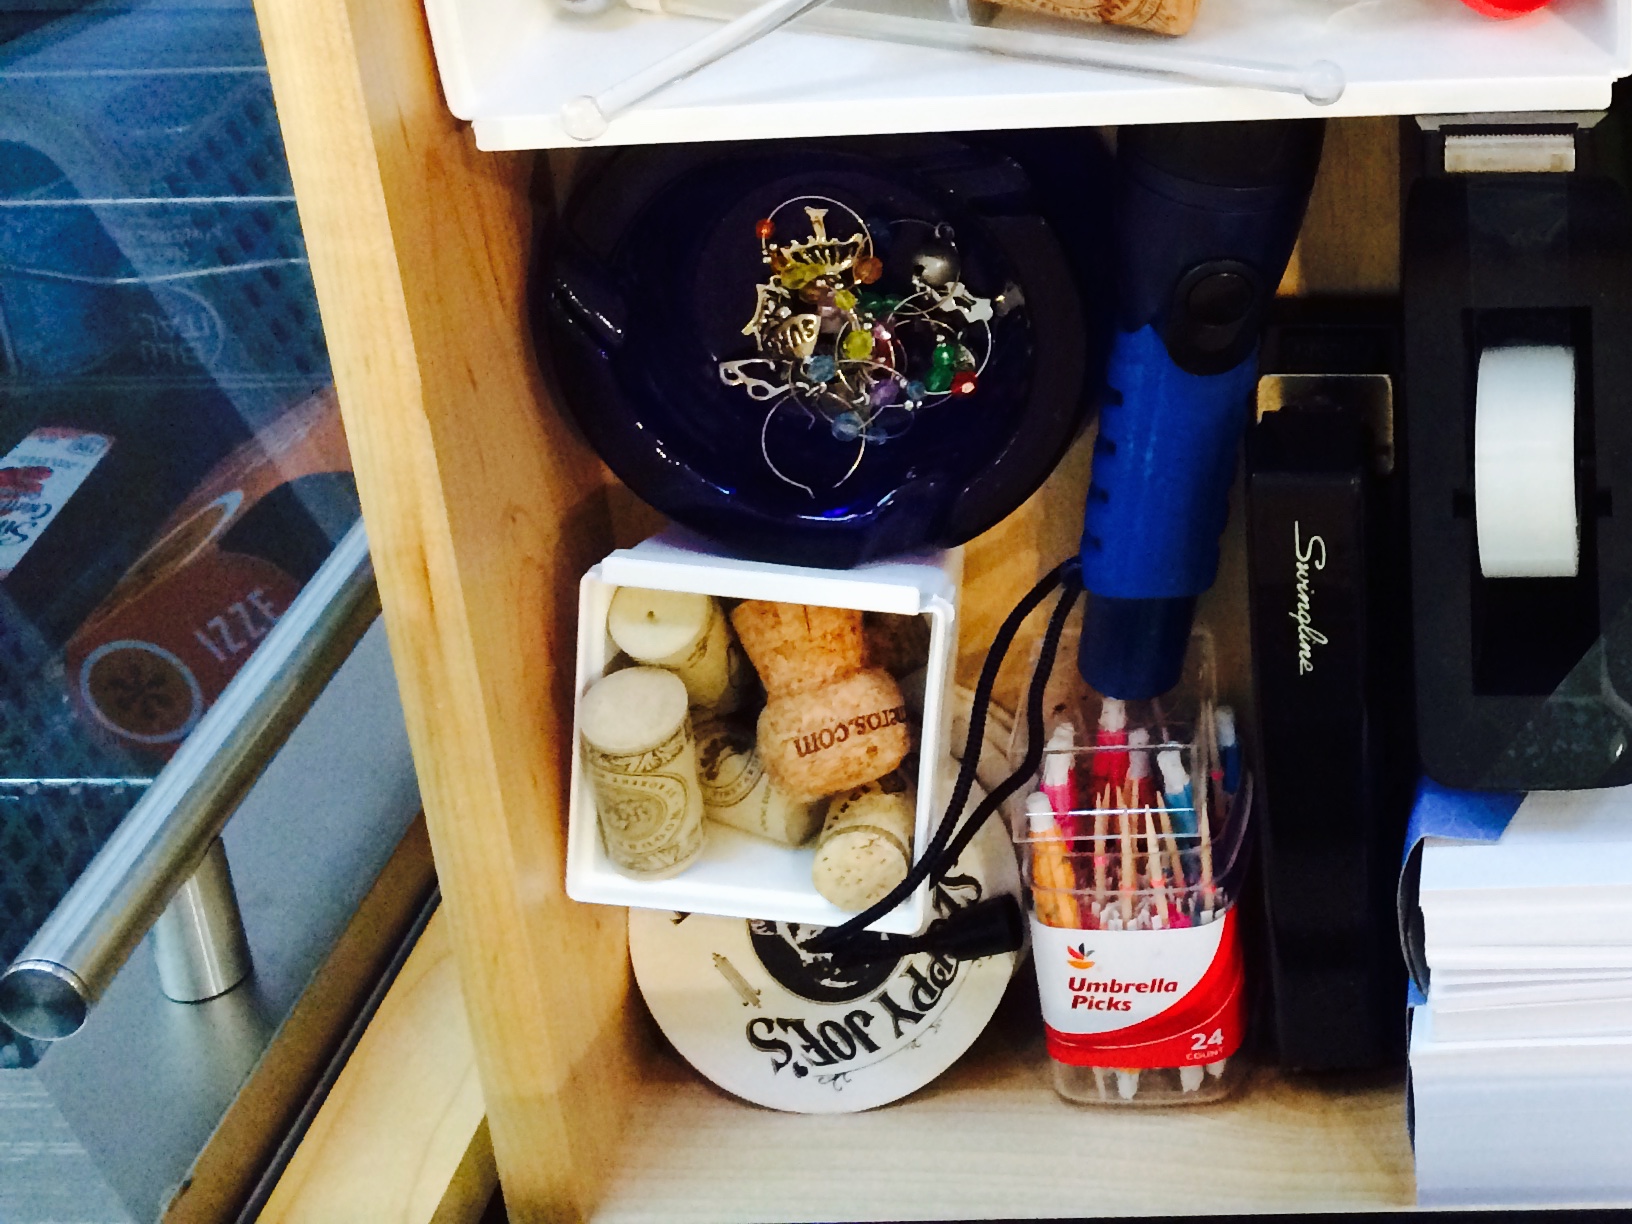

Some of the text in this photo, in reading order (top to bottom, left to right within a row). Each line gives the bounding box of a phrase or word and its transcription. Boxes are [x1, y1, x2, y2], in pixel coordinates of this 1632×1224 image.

[1289, 520, 1328, 676] Swingline
[1068, 977, 1179, 993] Umbrella
[1071, 995, 1132, 1012] Picks
[745, 1008, 882, 1079] JOE'S
[1190, 1028, 1225, 1051] 24
[1186, 1048, 1225, 1061] COUNT
